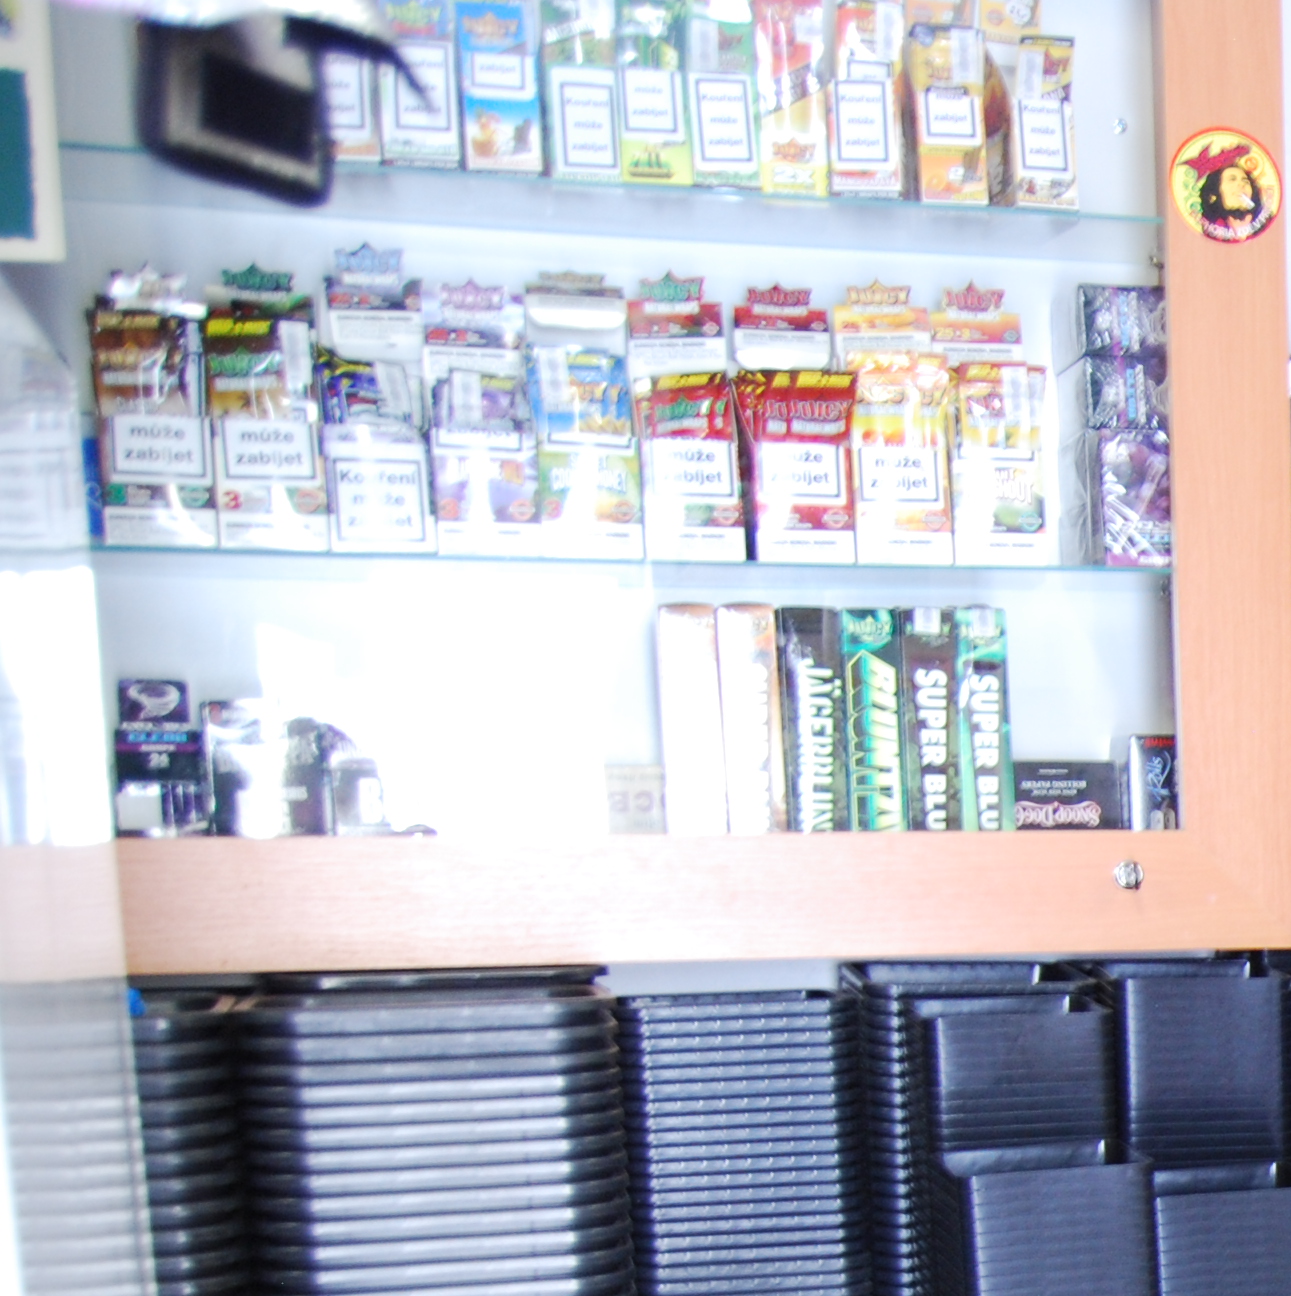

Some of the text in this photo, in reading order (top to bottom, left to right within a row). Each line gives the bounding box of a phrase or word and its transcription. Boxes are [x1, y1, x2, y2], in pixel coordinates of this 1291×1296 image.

[129, 424, 186, 441] může
[239, 429, 295, 445] může
[123, 445, 195, 466] zabijet
[235, 451, 304, 468] zabijet
[912, 668, 948, 832] SUPER BLU
[969, 673, 1000, 833] SUPER BLU
